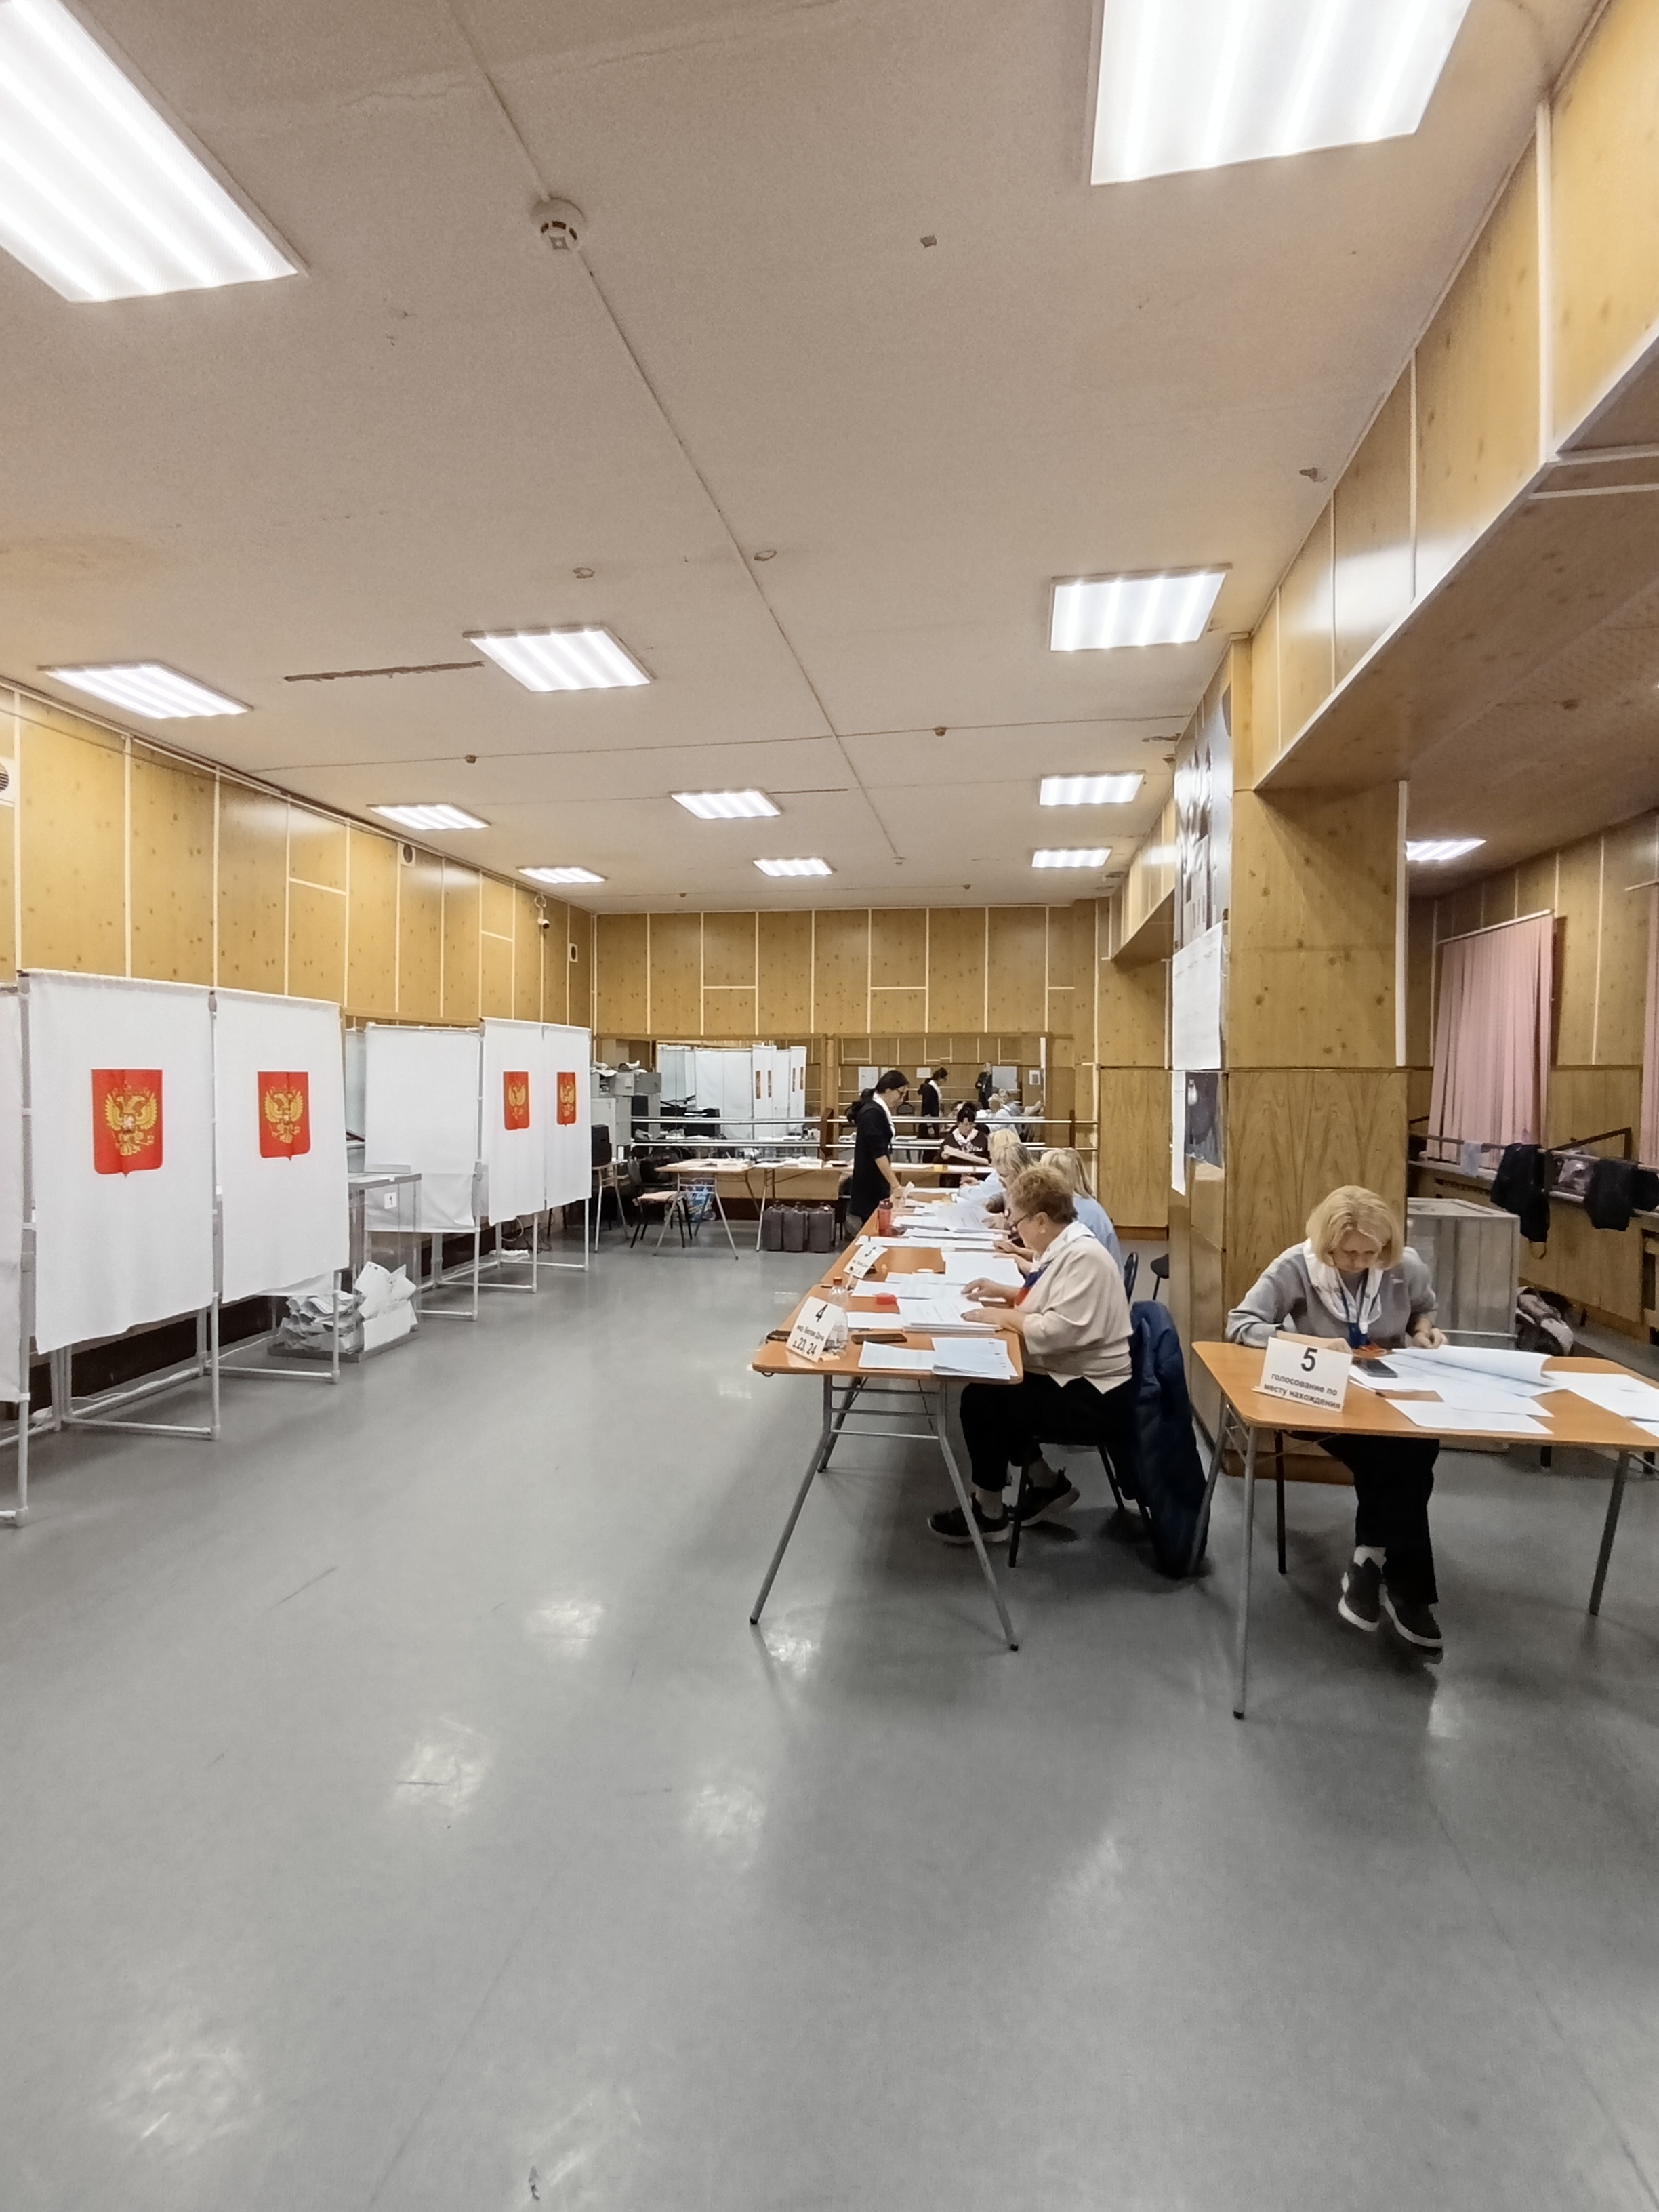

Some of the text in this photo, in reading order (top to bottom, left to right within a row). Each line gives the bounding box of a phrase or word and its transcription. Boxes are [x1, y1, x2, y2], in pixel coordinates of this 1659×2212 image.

[389, 1196, 393, 1205] 1
[815, 1303, 828, 1322] 4
[806, 1342, 817, 1355] 24
[1300, 1347, 1318, 1372] 5
[1271, 1373, 1337, 1397] голосование по
[1264, 1383, 1341, 1410] месту нахождения
